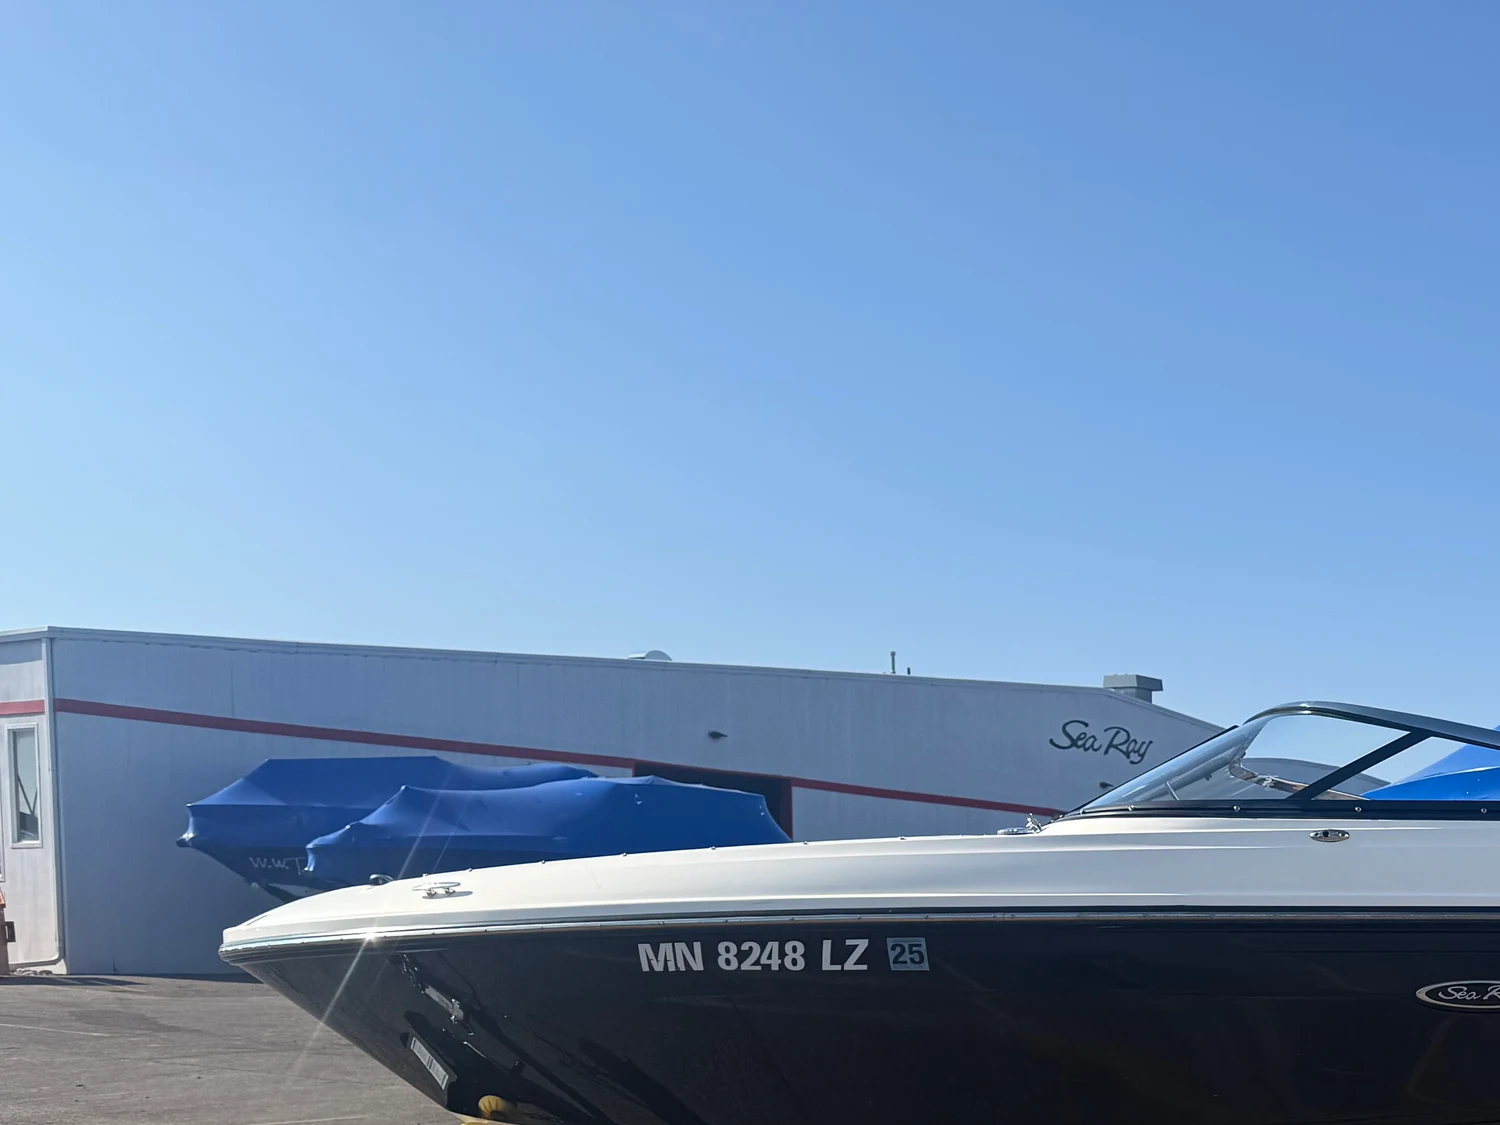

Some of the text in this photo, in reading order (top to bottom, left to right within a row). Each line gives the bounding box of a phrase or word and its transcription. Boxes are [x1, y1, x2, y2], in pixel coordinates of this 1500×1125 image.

[1049, 720, 1153, 764] Sea Ray
[638, 938, 869, 971] MN 8248 LZ
[890, 943, 925, 965] 25
[1438, 986, 1481, 1000] Sea
